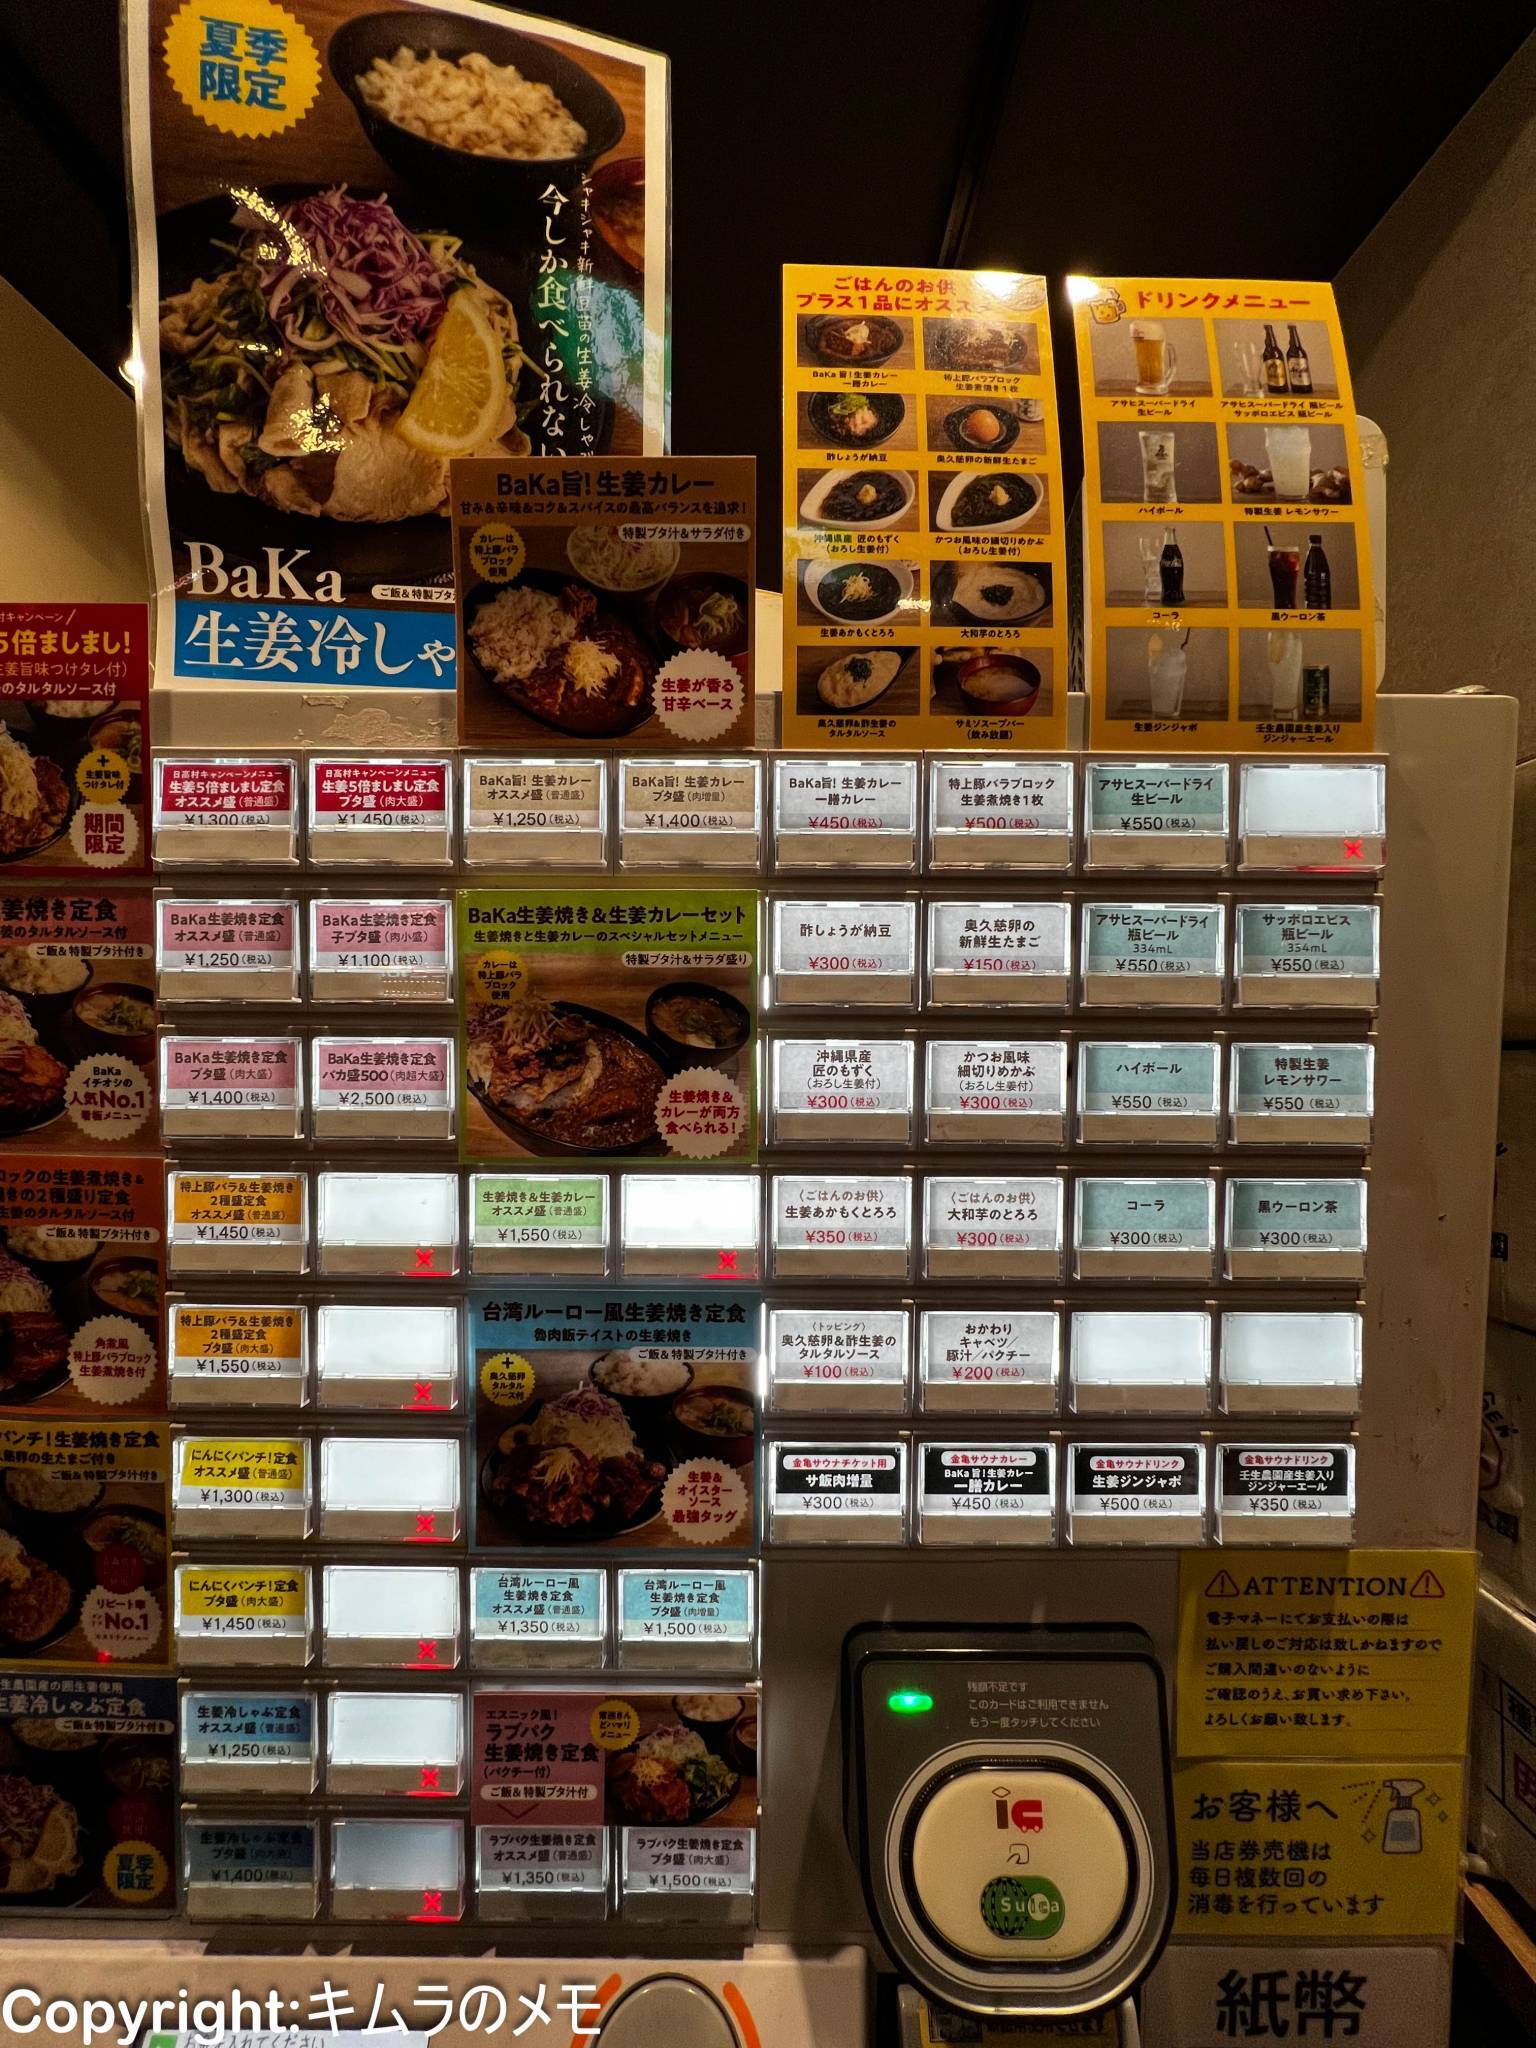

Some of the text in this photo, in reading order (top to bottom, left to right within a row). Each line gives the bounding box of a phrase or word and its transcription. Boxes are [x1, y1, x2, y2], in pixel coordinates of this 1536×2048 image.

[200, 16, 287, 65] 夏季
[200, 60, 286, 111] 限定
[834, 277, 956, 295] ごはんのお供
[1137, 291, 1310, 309] ドリンクメニュー
[596, 470, 714, 497] 生姜カレー
[184, 542, 346, 602] BaKa
[1152, 612, 1179, 620] コーラ
[662, 678, 734, 693] 生姜が香る
[663, 698, 733, 711] 甘辛ベース
[322, 780, 439, 793] 生姜5倍ましまし定食
[532, 775, 591, 786] 生姜カレー
[684, 776, 744, 787] 生姜カレー
[842, 778, 901, 790] 生姜カレー
[949, 778, 1054, 790] 特上豚バラブロック
[1099, 778, 1213, 790] アサヒスーパードライ
[169, 781, 285, 793] 生姜5倍ましまし定食
[961, 794, 1043, 806] 生姜煮焼き1枚
[1132, 794, 1182, 806] 生ビール
[84, 814, 124, 833] 期間
[85, 835, 124, 854] 限定
[171, 913, 284, 926] BaKa生姜焼き定食
[323, 913, 437, 927] BaKa生姜焼き定食
[468, 906, 745, 925] BaKa生姜焼き&生姜カレーセット
[1096, 915, 1208, 928] アサヒスーパードライ
[1262, 914, 1350, 926] サッポロエビス
[800, 924, 891, 937] 酢しょうが納豆
[964, 920, 1034, 932] 奥久慈卵の
[1128, 929, 1178, 941] 瓶ビール
[1282, 928, 1332, 940] 瓶ビール
[959, 936, 1040, 948] 新鮮生たまご
[1133, 944, 1172, 954] 334mL
[175, 1051, 288, 1064] BaKa生姜焼き定食
[328, 1053, 436, 1066] BaKa生姜焼き定食
[817, 1050, 872, 1062] 沖縄県産
[964, 1052, 1030, 1063] かつお風味
[1117, 1062, 1182, 1074] ハイボール
[1275, 1058, 1329, 1070] 特製生姜
[93, 1067, 121, 1075] BaKa
[813, 1064, 872, 1077] 匠のもずく
[958, 1065, 1035, 1078] 細切りめかぶ
[83, 1078, 132, 1087] イチオシの
[1264, 1075, 1341, 1086] レモンサワー
[70, 1091, 144, 1108] 人気No.1
[669, 1091, 732, 1103] 生姜焼き&
[661, 1106, 739, 1118] カレーが両方
[665, 1121, 736, 1134] 食べられる!
[210, 1195, 267, 1206] 2種盛定食
[483, 1192, 595, 1202] 生姜焼き&生姜カレー
[1127, 1201, 1165, 1211] コーラ
[1258, 1201, 1338, 1213] 黒ウーロン茶
[786, 1207, 896, 1218] 生姜あかもくとろろ
[948, 1209, 1038, 1220] 大和芋のとろろ
[482, 1302, 746, 1322] 台湾ルーロー風生姜焼き定食
[210, 1329, 266, 1340] 2種盛定食
[966, 1323, 1012, 1334] おかわり
[799, 1348, 879, 1360] タルタルソース
[792, 1458, 886, 1468] 金亀サウナチケット用
[951, 1454, 1027, 1464] 金亀サウナカレー
[1096, 1459, 1179, 1469] 金亀サウナドリンク
[1245, 1455, 1328, 1464] 金亀サウナドリンク
[806, 1474, 872, 1488] サ飯肉増量
[1093, 1475, 1182, 1488] 生姜ジンジャポ
[1248, 1482, 1327, 1491] ジンジャーエール
[678, 1486, 732, 1495] オイスター
[689, 1498, 720, 1507] ソース
[672, 1510, 737, 1522] 最強タッグ
[499, 1578, 579, 1589] 台湾ルーロー風
[644, 1580, 726, 1590] 台湾ルーロー風
[1243, 1577, 1407, 1596] ATTENTION
[504, 1590, 573, 1602] 生姜焼き定食
[650, 1592, 719, 1603] 生姜焼き定食
[105, 1612, 148, 1630] No.1
[484, 1744, 598, 1762] 生姜焼き定食
[1191, 1790, 1338, 1822] お客様へ
[1191, 1840, 1331, 1861] 当店券売機は
[1189, 1868, 1327, 1888] 毎日複数回の
[1001, 1896, 1059, 1914] Suica
[1188, 1894, 1383, 1914] 消毒を行っています
[1216, 1969, 1366, 2038] 紙幣
